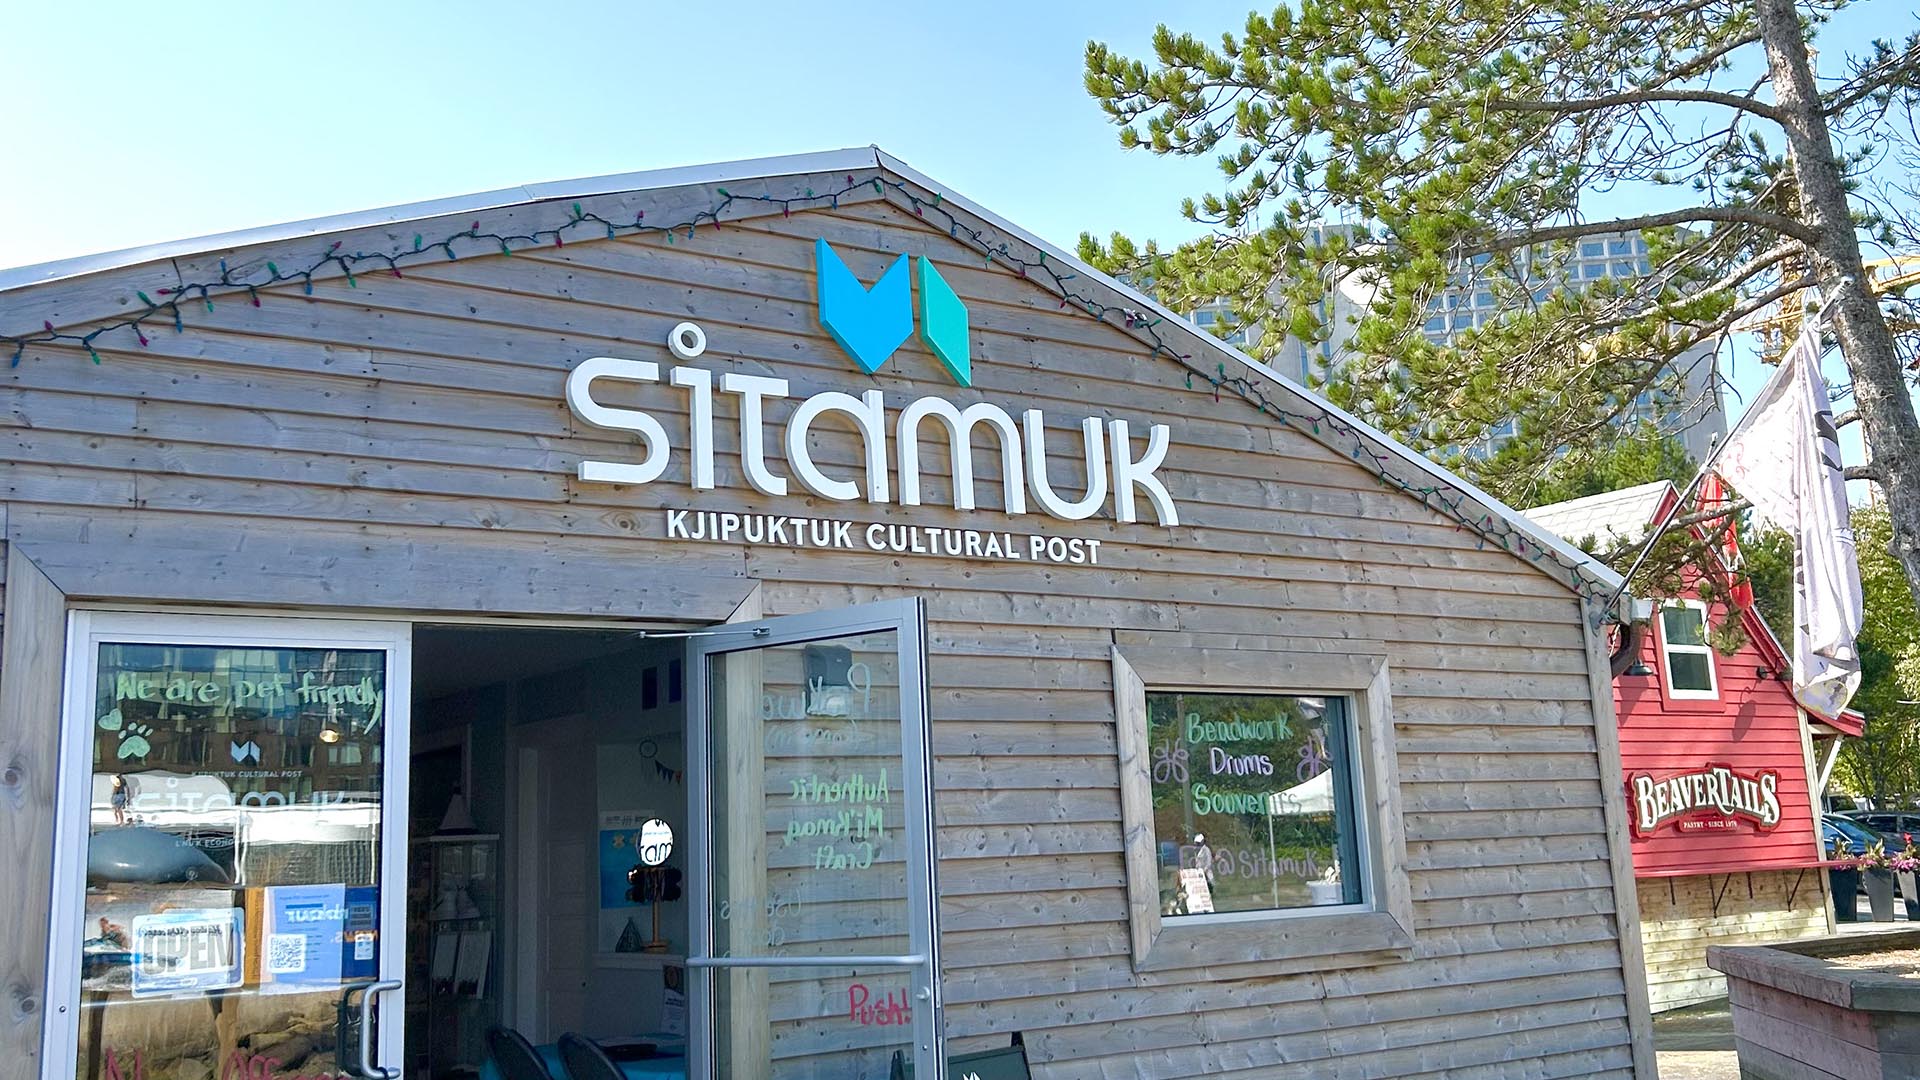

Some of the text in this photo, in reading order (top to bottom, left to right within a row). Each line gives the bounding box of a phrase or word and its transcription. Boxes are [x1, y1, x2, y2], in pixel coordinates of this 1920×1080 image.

[667, 510, 1101, 565] KJIPUKTUK CULTURAL POST
[165, 677, 221, 703] are
[234, 672, 292, 708] pet
[295, 670, 383, 735] friendly
[238, 770, 280, 778] CULTURAL
[281, 770, 304, 778] POST
[1209, 746, 1274, 776] Drums
[1191, 782, 1302, 816] Souvenirs
[143, 923, 234, 976] OPEN
[848, 984, 911, 1025] Push!
